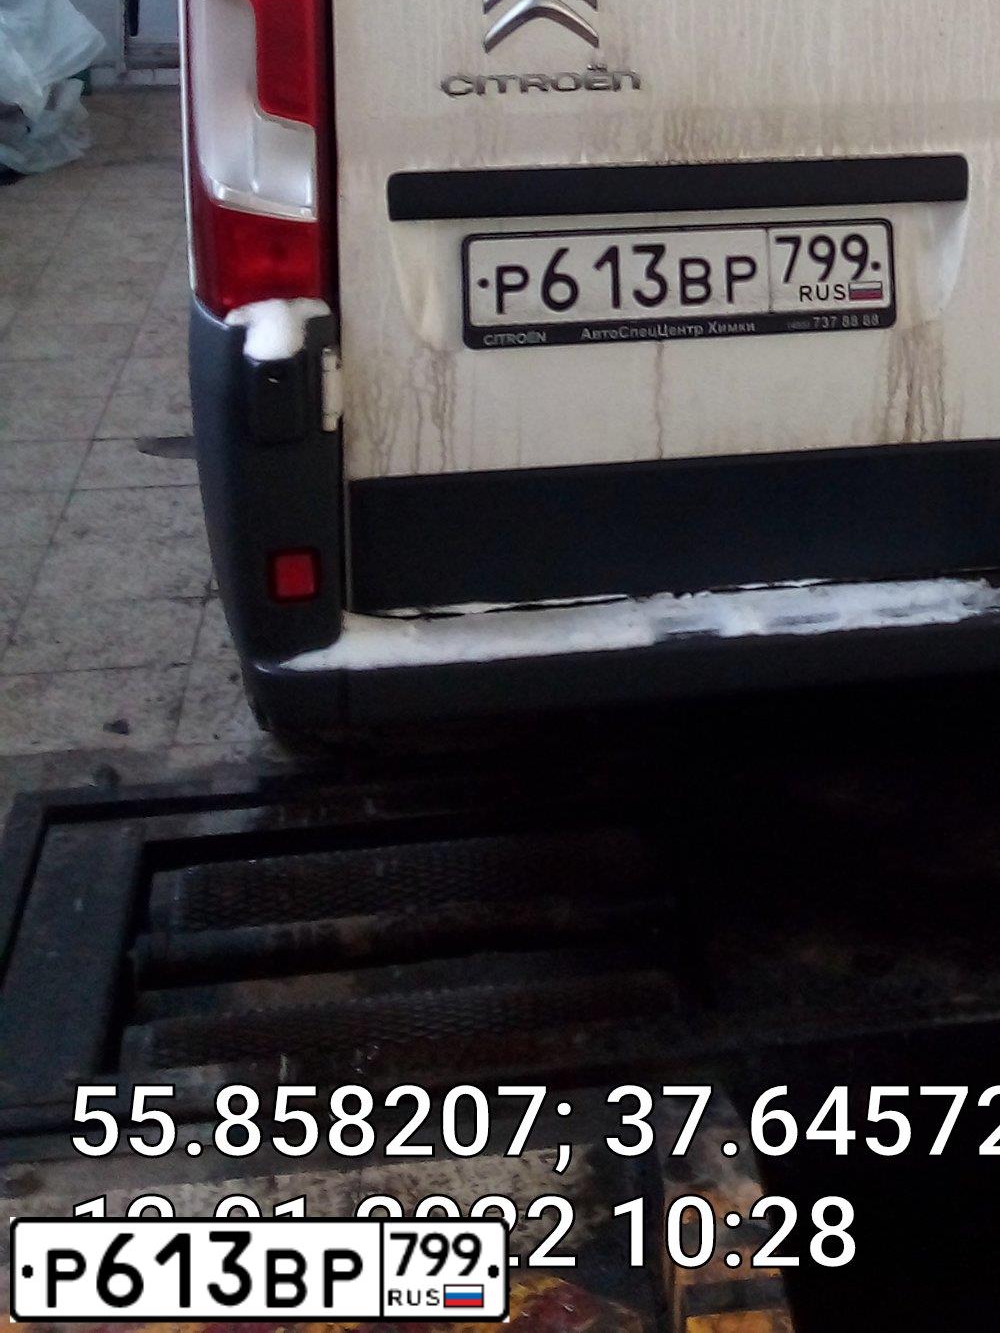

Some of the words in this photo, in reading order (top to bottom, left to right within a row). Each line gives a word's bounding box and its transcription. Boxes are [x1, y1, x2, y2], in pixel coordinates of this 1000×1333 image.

[774, 233, 869, 284] 799
[799, 283, 846, 303] RUS
[707, 319, 756, 336] Химки
[812, 316, 837, 329] 737
